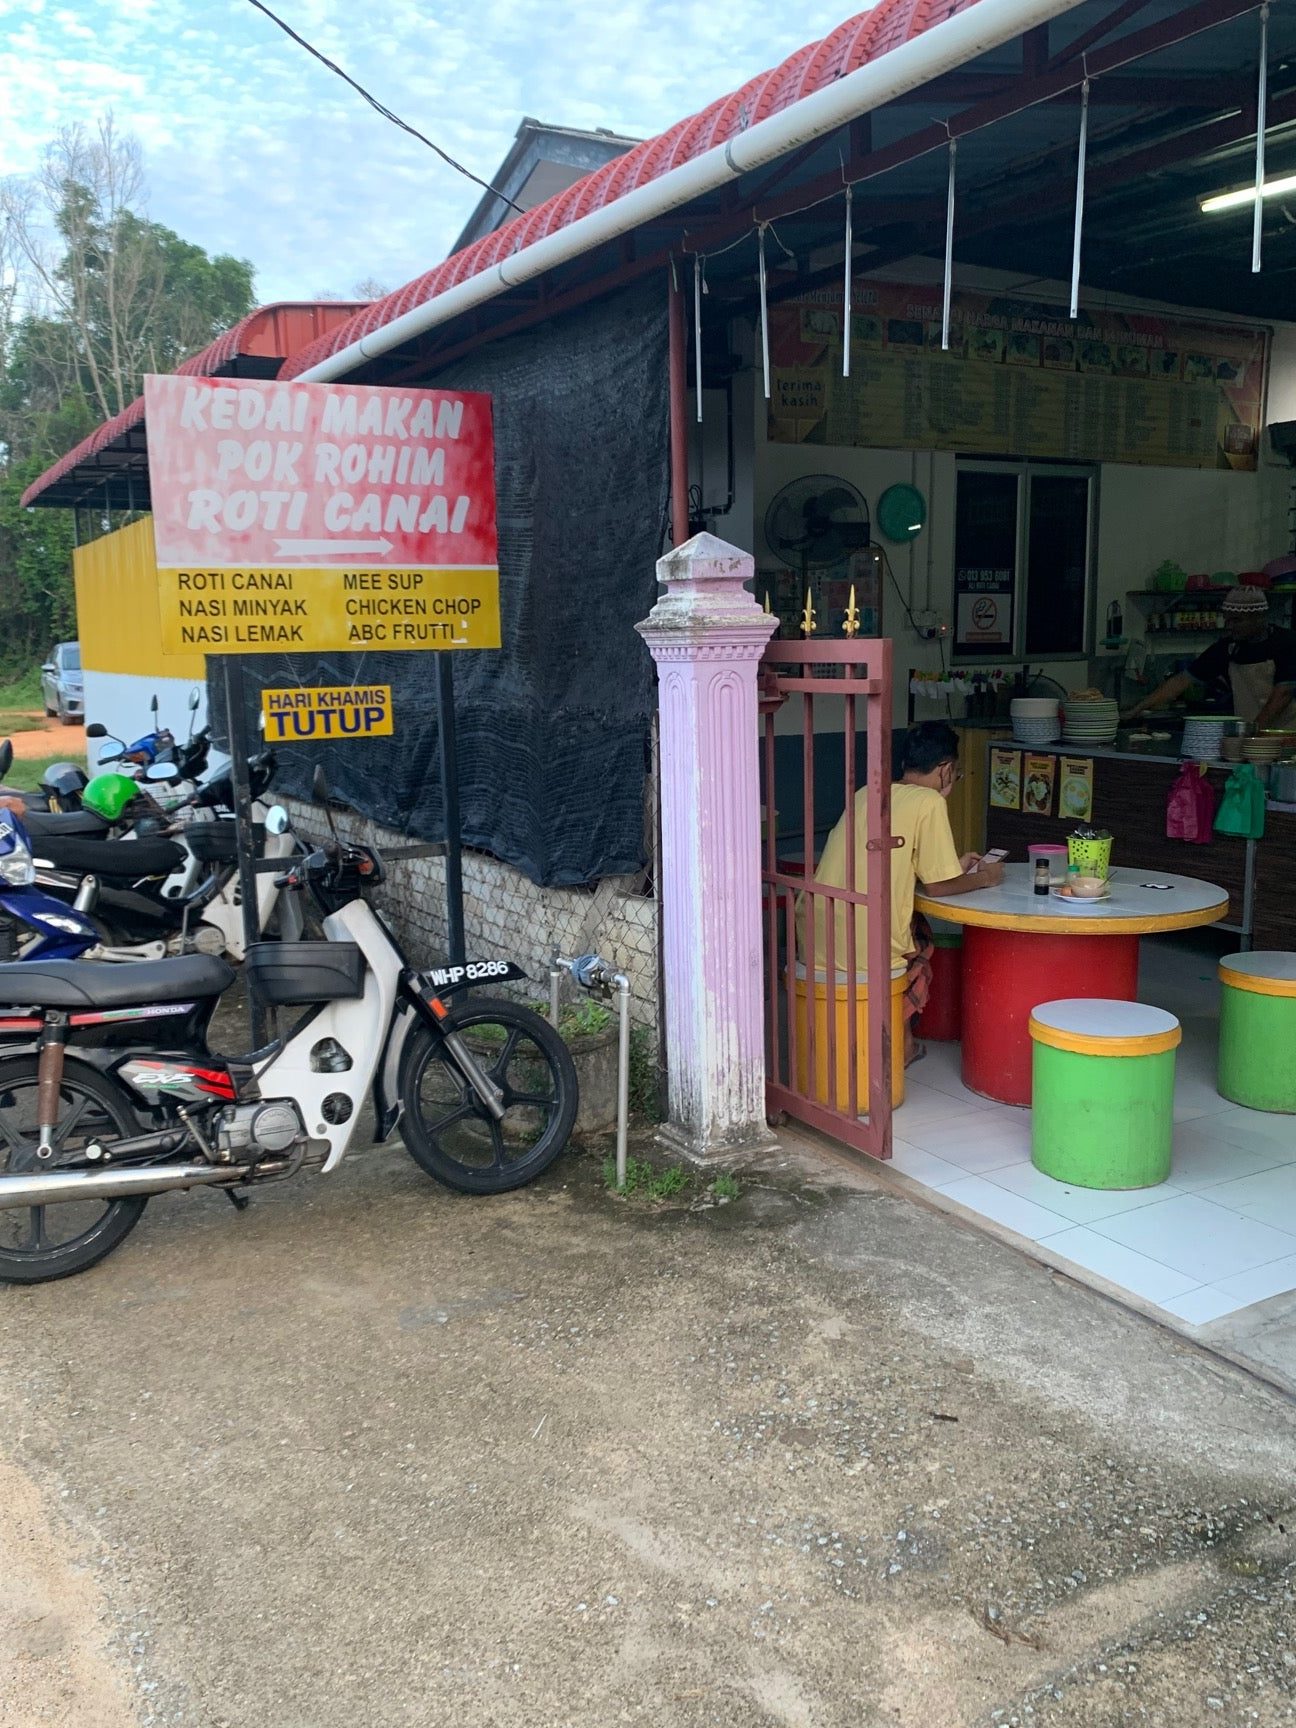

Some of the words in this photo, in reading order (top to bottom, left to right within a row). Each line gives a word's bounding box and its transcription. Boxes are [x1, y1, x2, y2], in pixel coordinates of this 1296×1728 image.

[180, 385, 310, 432] KEDAI
[321, 394, 464, 440] MAKAN
[217, 439, 304, 485] POK
[314, 442, 445, 486] ROHIM
[187, 488, 308, 534] ROTI
[324, 492, 470, 533] CANAI
[178, 573, 225, 590] ROTI
[232, 573, 293, 590] CANAI
[344, 573, 382, 590] MEE
[388, 573, 423, 590] SUP
[179, 599, 227, 617] NASI
[233, 599, 308, 616] MINYAK
[346, 598, 426, 615] CHICKEN
[432, 598, 481, 615] CHOP
[181, 625, 229, 643] NASI
[235, 624, 304, 642] LEMAK
[348, 624, 386, 641] ABC
[393, 623, 454, 640] FRUTTI
[268, 693, 312, 709] HARI
[317, 689, 386, 707] KHAMIS
[269, 706, 385, 737] TUTUP
[430, 966, 465, 986] WHP
[465, 960, 509, 980] 8286
[146, 1006, 185, 1015] HONDA
[132, 1072, 196, 1084] EX5
